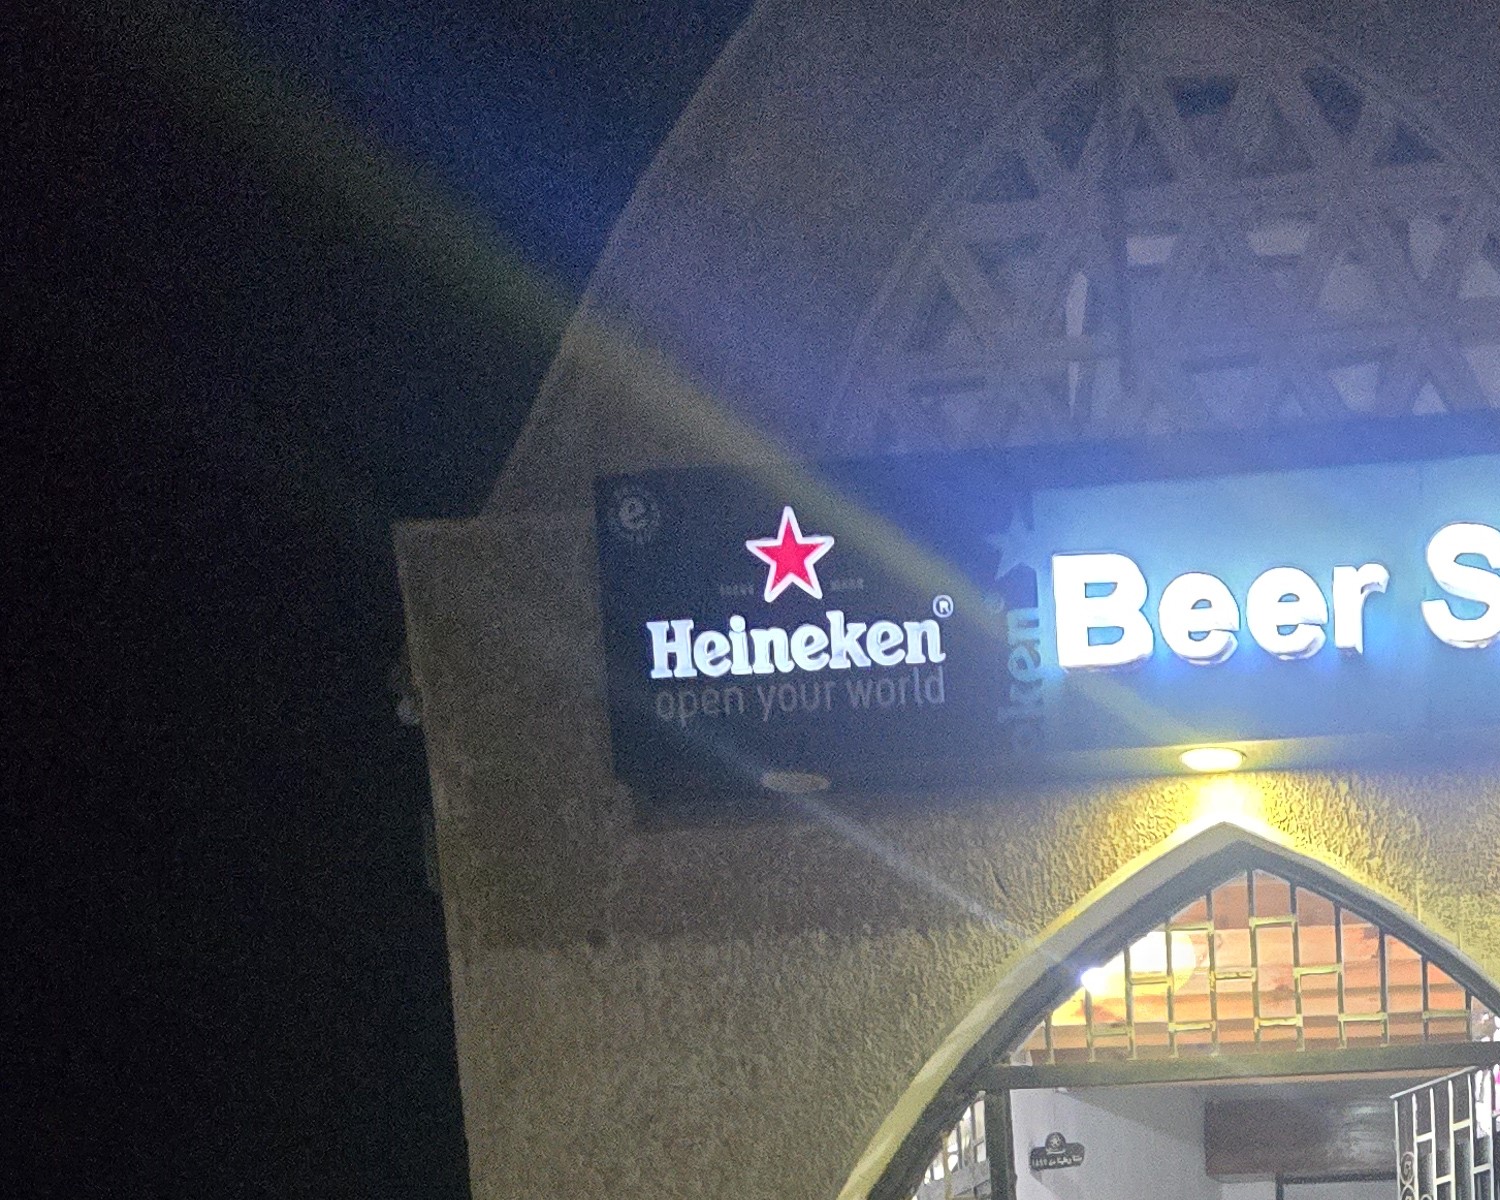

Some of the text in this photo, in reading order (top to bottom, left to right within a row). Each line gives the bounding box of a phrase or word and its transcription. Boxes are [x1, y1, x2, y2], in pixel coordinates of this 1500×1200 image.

[646, 610, 946, 679] Heineken
[1052, 552, 1390, 671] Beer
[655, 666, 946, 727] open your world
